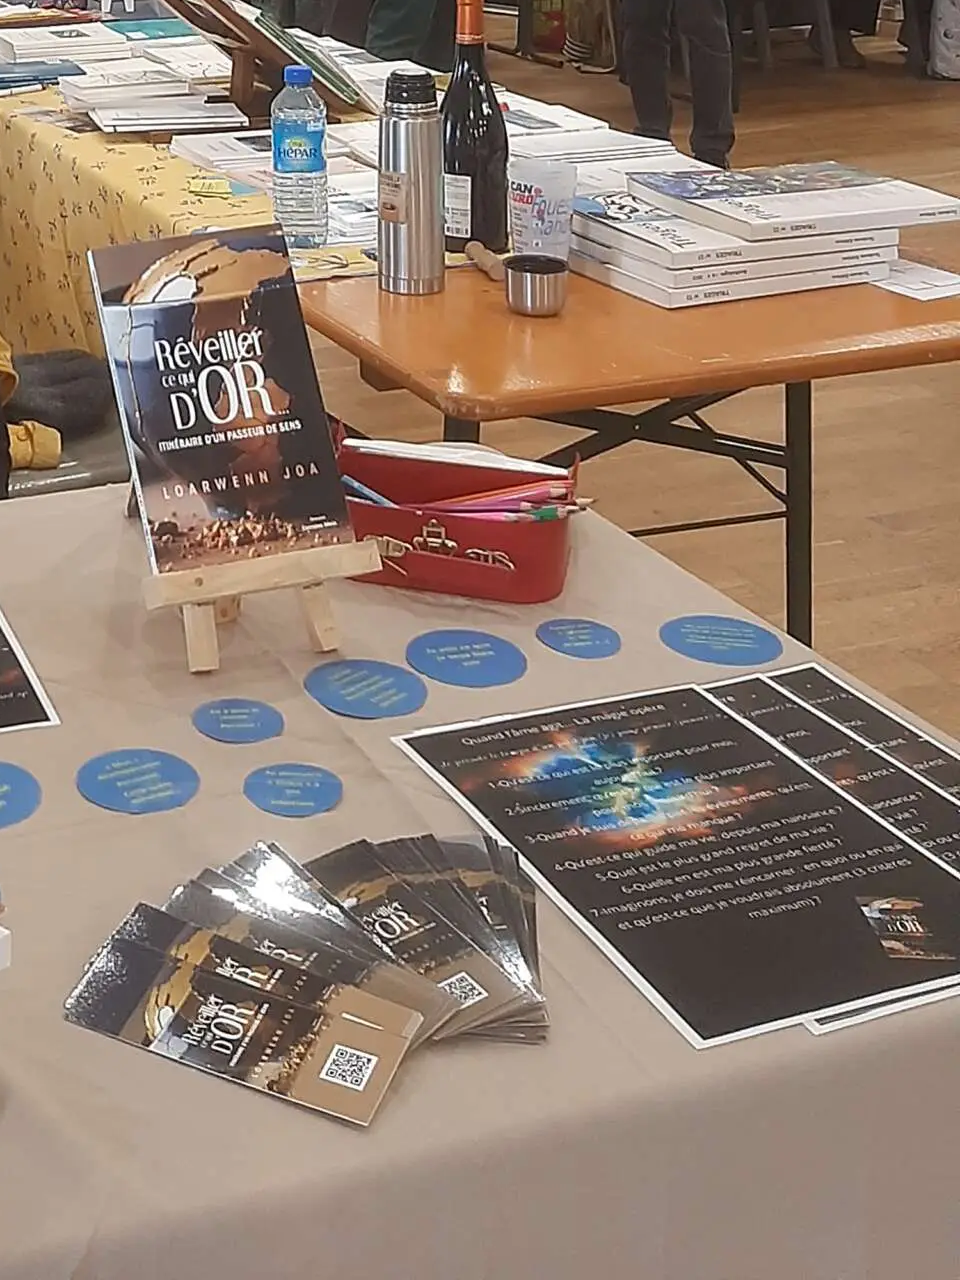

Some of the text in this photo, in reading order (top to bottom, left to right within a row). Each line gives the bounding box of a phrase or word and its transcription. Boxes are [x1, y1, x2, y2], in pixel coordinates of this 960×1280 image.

[153, 329, 263, 371] Réveiller
[161, 368, 195, 388] ce qui
[157, 419, 301, 452] ITINÉRAIRE D'UN PASSEUR DE SENS
[162, 462, 320, 499] LOARWENN JOA
[461, 732, 504, 745] Quand
[572, 717, 590, 725] La
[591, 711, 628, 721] magie
[629, 704, 665, 715] opère
[683, 744, 709, 755] pour
[694, 772, 719, 783] plus
[718, 760, 774, 776] important
[524, 782, 812, 843] 3-Quand qu'est
[687, 815, 736, 828] manque
[595, 866, 637, 881] 5-Quel
[638, 863, 658, 873] est
[672, 856, 699, 867] plus
[699, 846, 735, 861] grand
[735, 839, 773, 852] regret
[772, 835, 788, 843] de
[788, 830, 809, 839] ma
[809, 826, 827, 834] vie
[622, 850, 642, 860] qui
[643, 843, 677, 856] guide
[677, 839, 698, 848] ma
[720, 826, 760, 839] depuis
[760, 821, 781, 829] ma
[780, 808, 836, 824] naissance
[621, 840, 835, 893] 6-Quelle en est ma plus grande fierté
[671, 892, 684, 902] je
[685, 887, 712, 897] dois
[712, 882, 733, 891] me
[734, 868, 795, 886] réincarner
[803, 862, 821, 870] en
[820, 856, 848, 866] quoi
[848, 852, 866, 860] ou
[866, 848, 883, 856] en
[882, 843, 903, 852] qui
[618, 921, 633, 930] et
[689, 903, 715, 914] que
[714, 900, 728, 910] je
[728, 888, 782, 904] voudrais
[783, 871, 853, 893] absolument
[867, 858, 911, 873] critères
